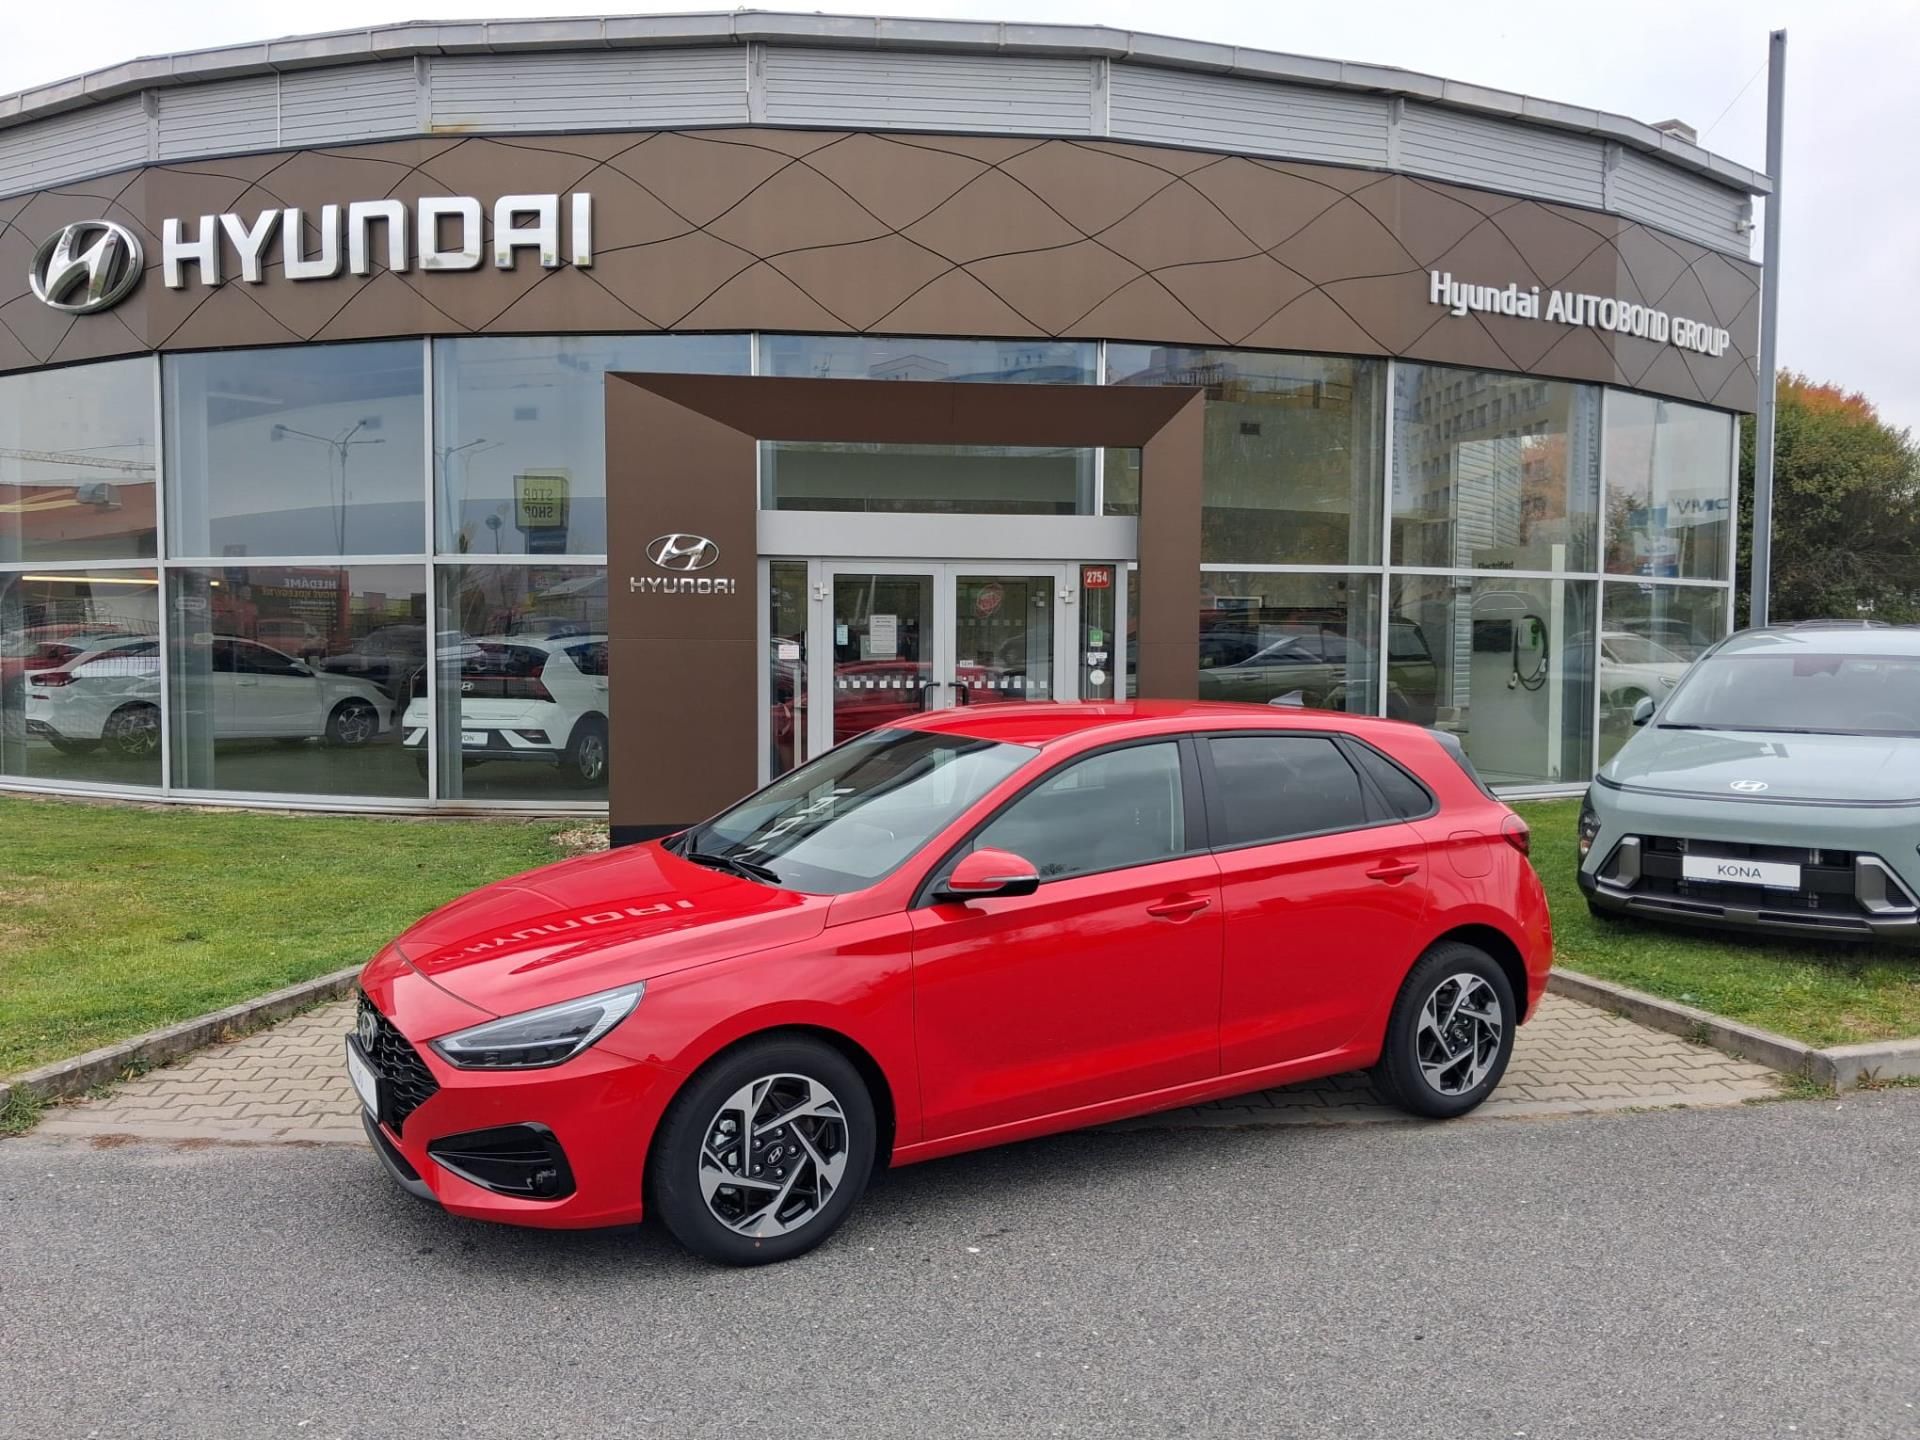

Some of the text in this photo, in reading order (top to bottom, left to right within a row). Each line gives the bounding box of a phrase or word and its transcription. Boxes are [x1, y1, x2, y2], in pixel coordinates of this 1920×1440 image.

[162, 192, 592, 289] HYUNDAI
[1430, 270, 1730, 358] Hyundai AUTOBOND GROUP
[630, 577, 735, 594] HYUNDAI
[1086, 571, 1108, 583] 2754
[1718, 865, 1761, 879] KONA
